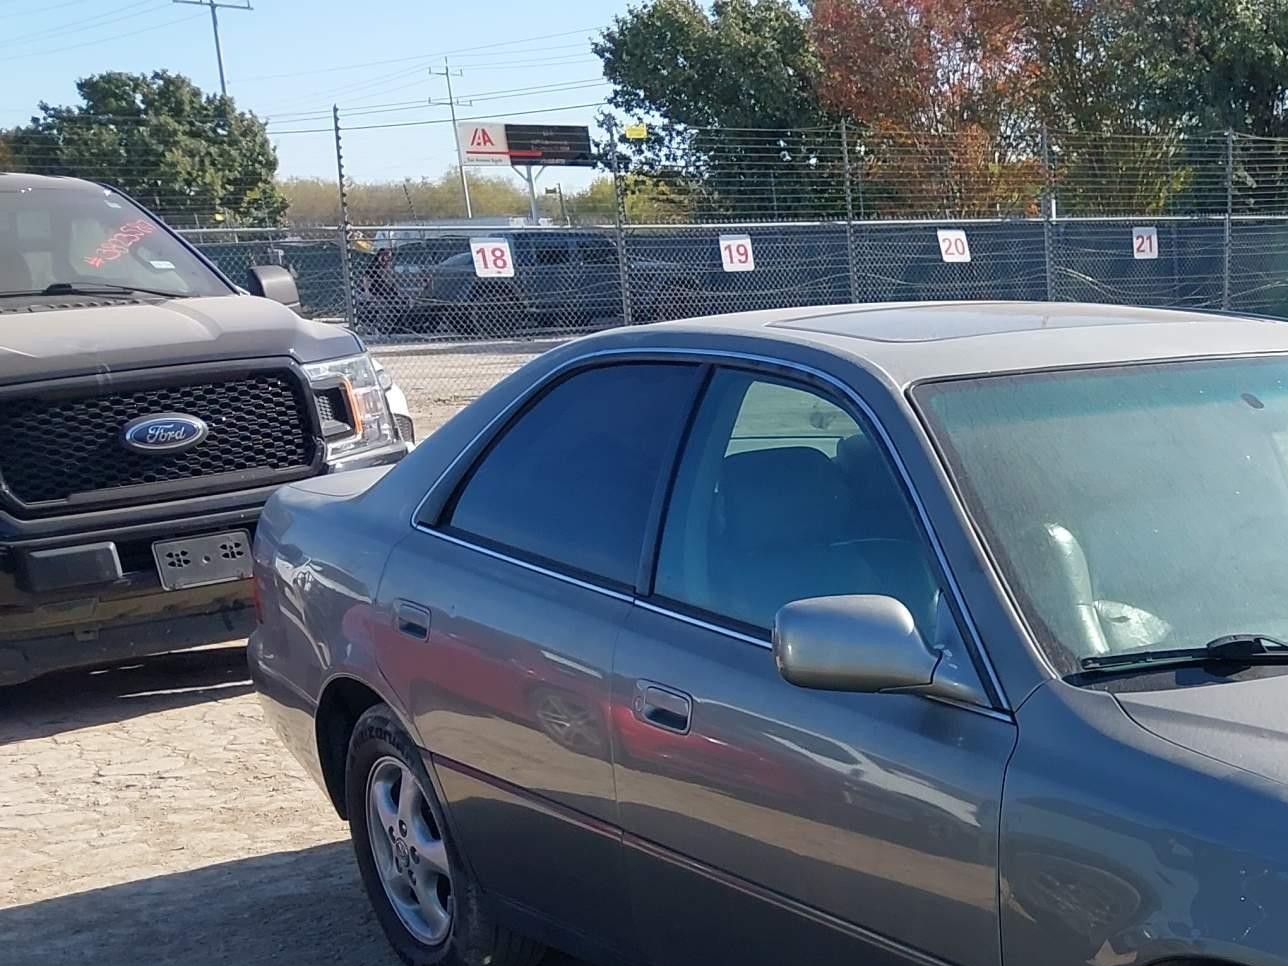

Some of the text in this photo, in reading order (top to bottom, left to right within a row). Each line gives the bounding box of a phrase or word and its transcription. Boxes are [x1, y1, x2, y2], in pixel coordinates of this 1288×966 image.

[941, 237, 966, 256] 20
[1135, 234, 1155, 253] 21
[476, 247, 507, 270] 18
[723, 243, 750, 265] 19
[146, 424, 187, 443] Ford
